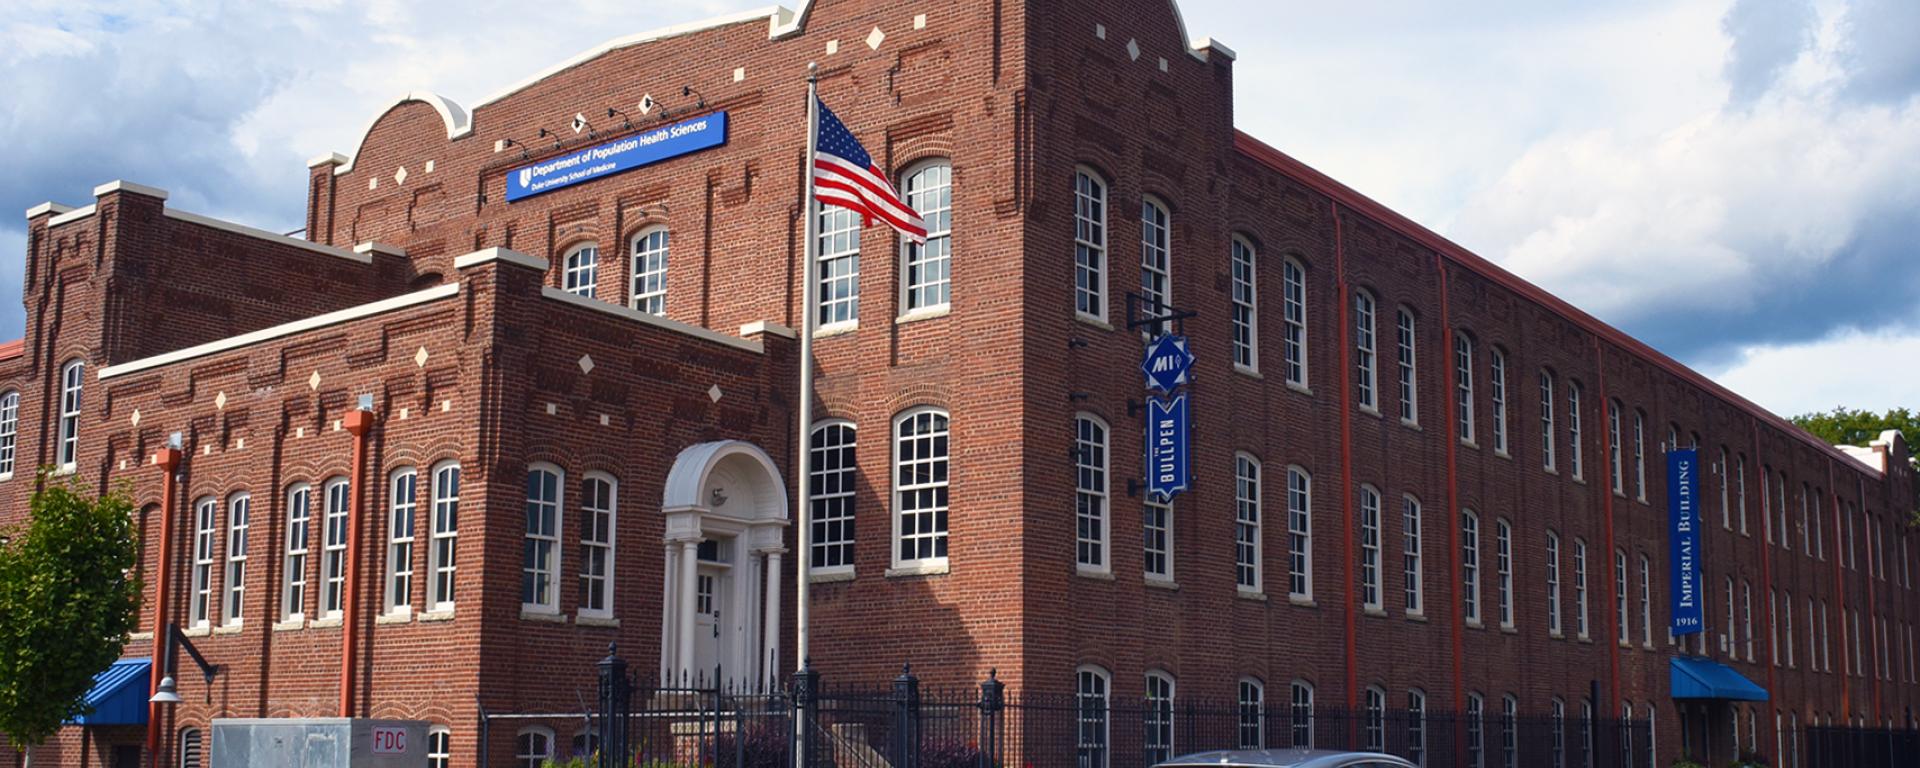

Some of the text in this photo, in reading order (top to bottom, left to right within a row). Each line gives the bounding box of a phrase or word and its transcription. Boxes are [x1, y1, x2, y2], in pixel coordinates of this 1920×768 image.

[532, 120, 708, 177] Department of Population Health Sciences
[531, 182, 545, 192] Duke
[544, 175, 569, 187] University
[569, 169, 586, 181] School
[592, 162, 617, 173] Medicine
[1160, 419, 1175, 483] BULLPEN
[1676, 617, 1698, 627] 1916
[375, 730, 405, 750] FDC
